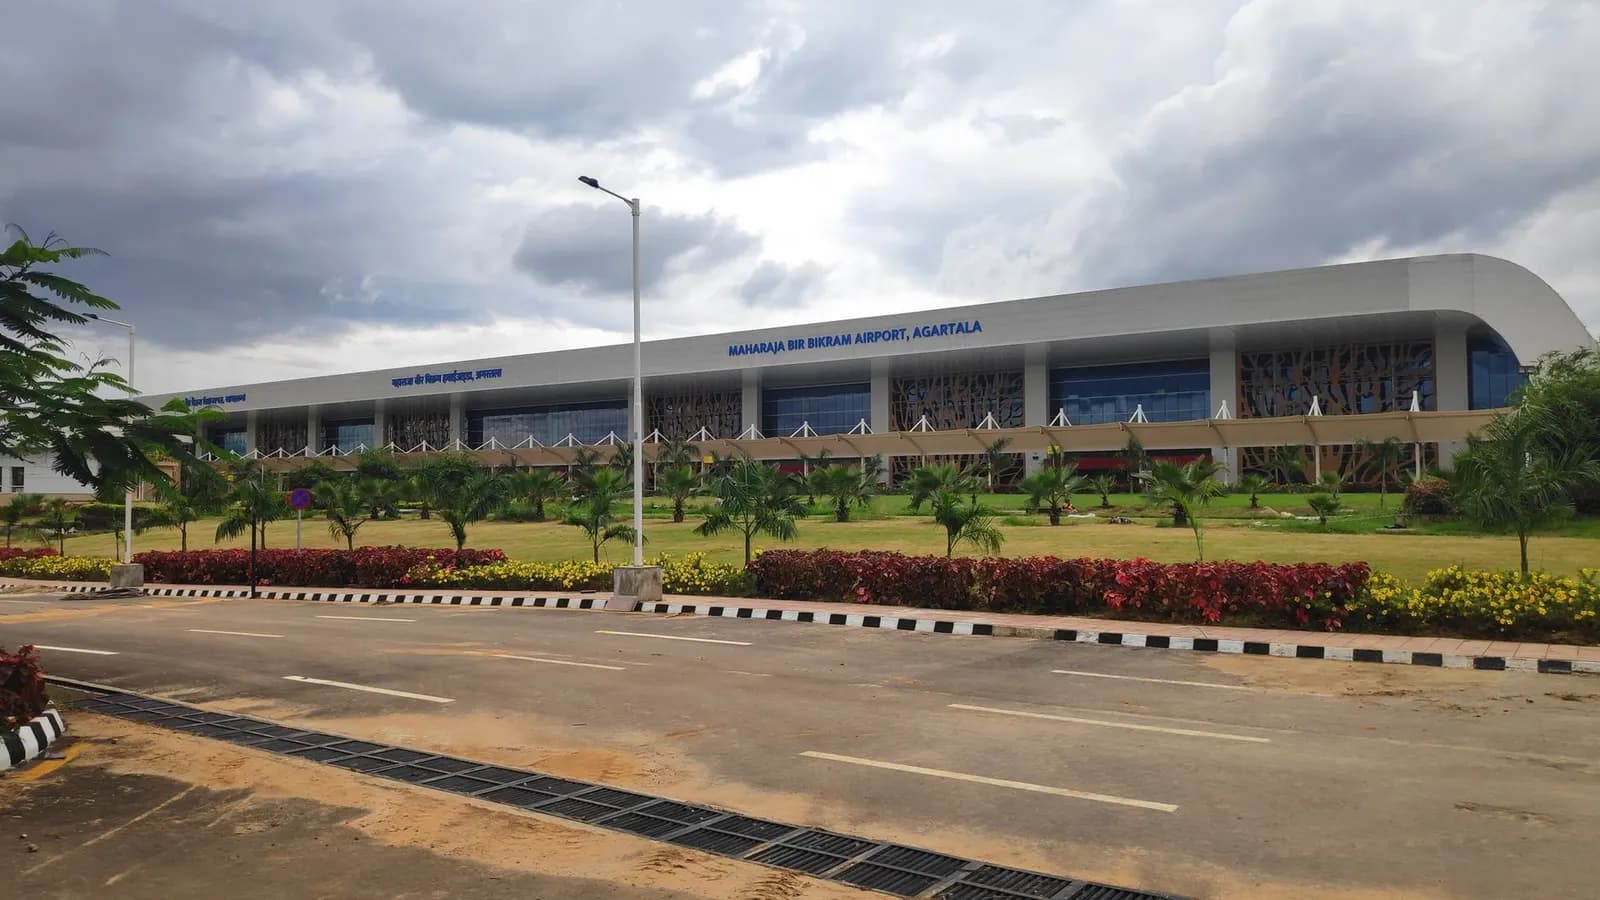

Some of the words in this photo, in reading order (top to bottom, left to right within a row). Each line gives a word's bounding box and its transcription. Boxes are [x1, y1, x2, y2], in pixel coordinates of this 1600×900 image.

[728, 341, 785, 356] MAHARAJA
[787, 339, 805, 351] BIR
[807, 334, 852, 349] BIKRAM
[854, 328, 910, 344] AIRPORT,
[912, 320, 982, 339] AGARTALA
